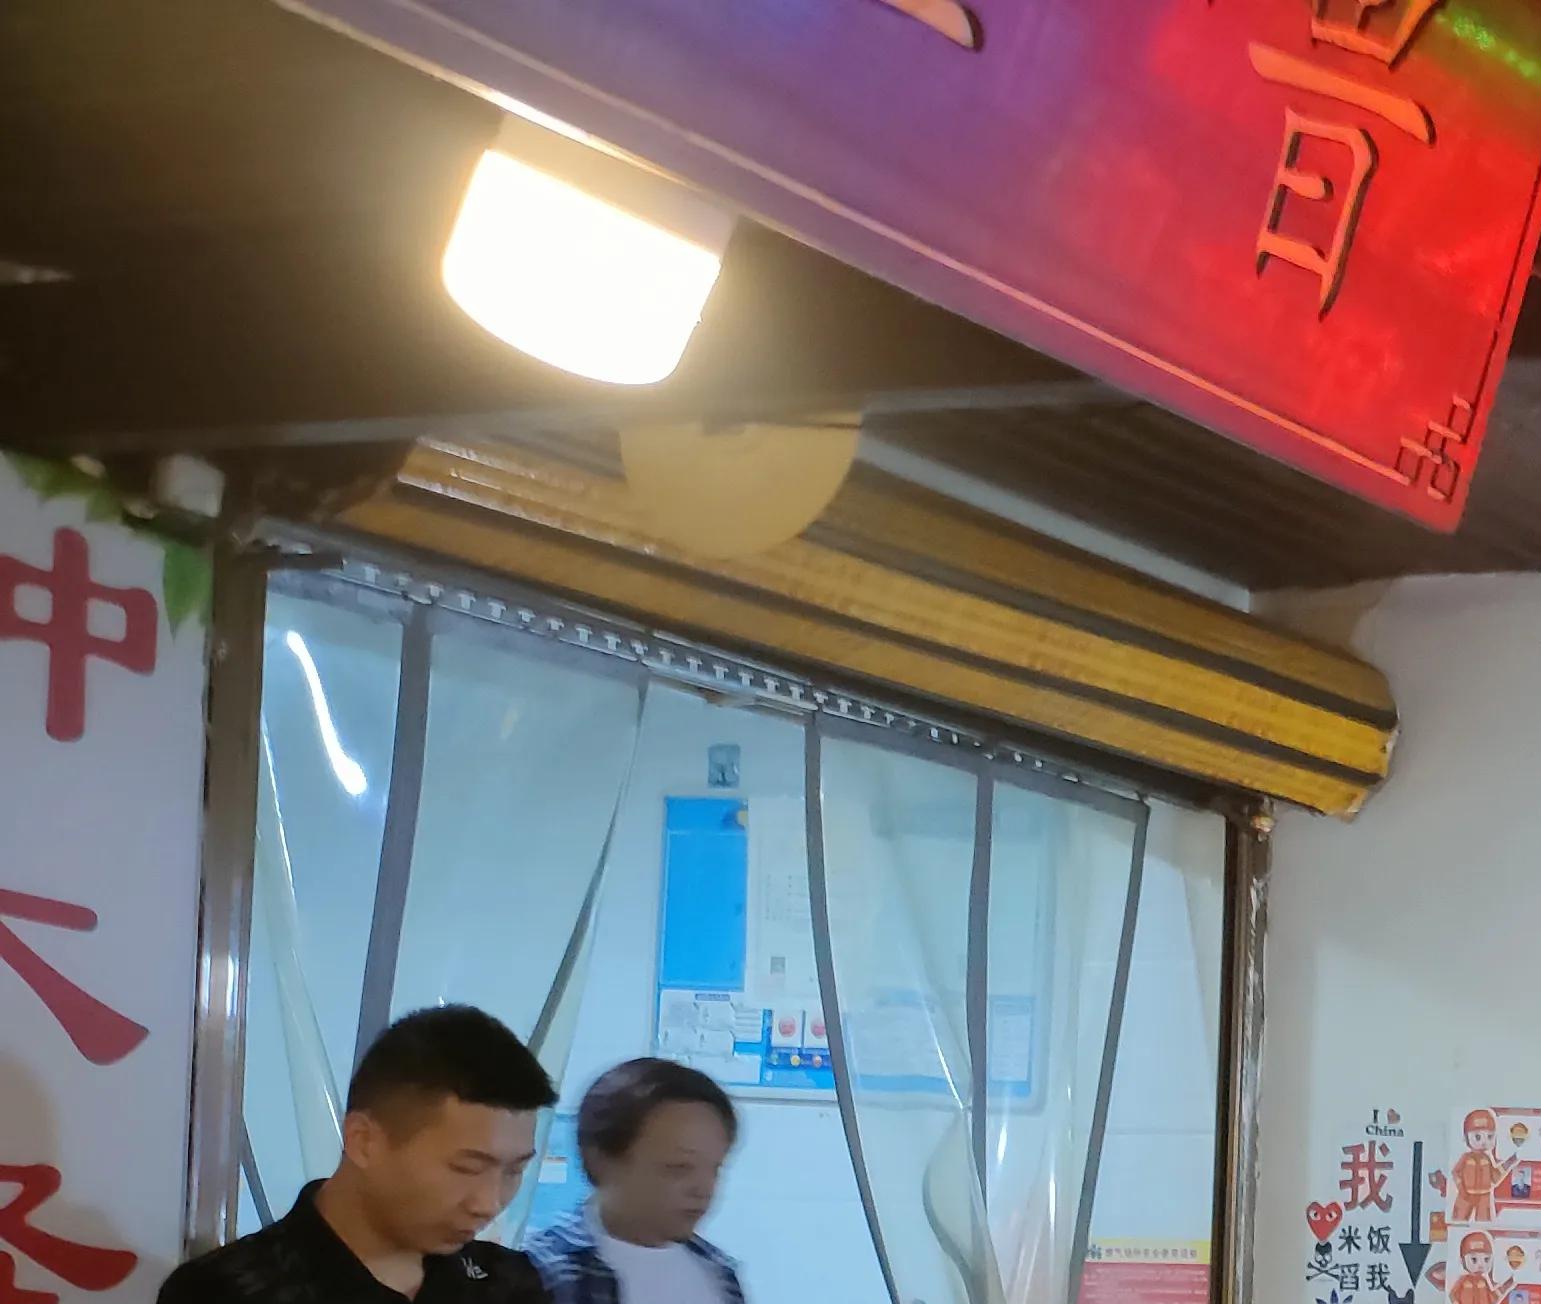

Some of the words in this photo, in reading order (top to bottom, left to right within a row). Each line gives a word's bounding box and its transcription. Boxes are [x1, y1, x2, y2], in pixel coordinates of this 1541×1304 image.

[1372, 1109, 1379, 1124] I
[1365, 1124, 1405, 1138] China
[1339, 1140, 1394, 1213] 我
[1337, 1225, 1392, 1255] 米饭
